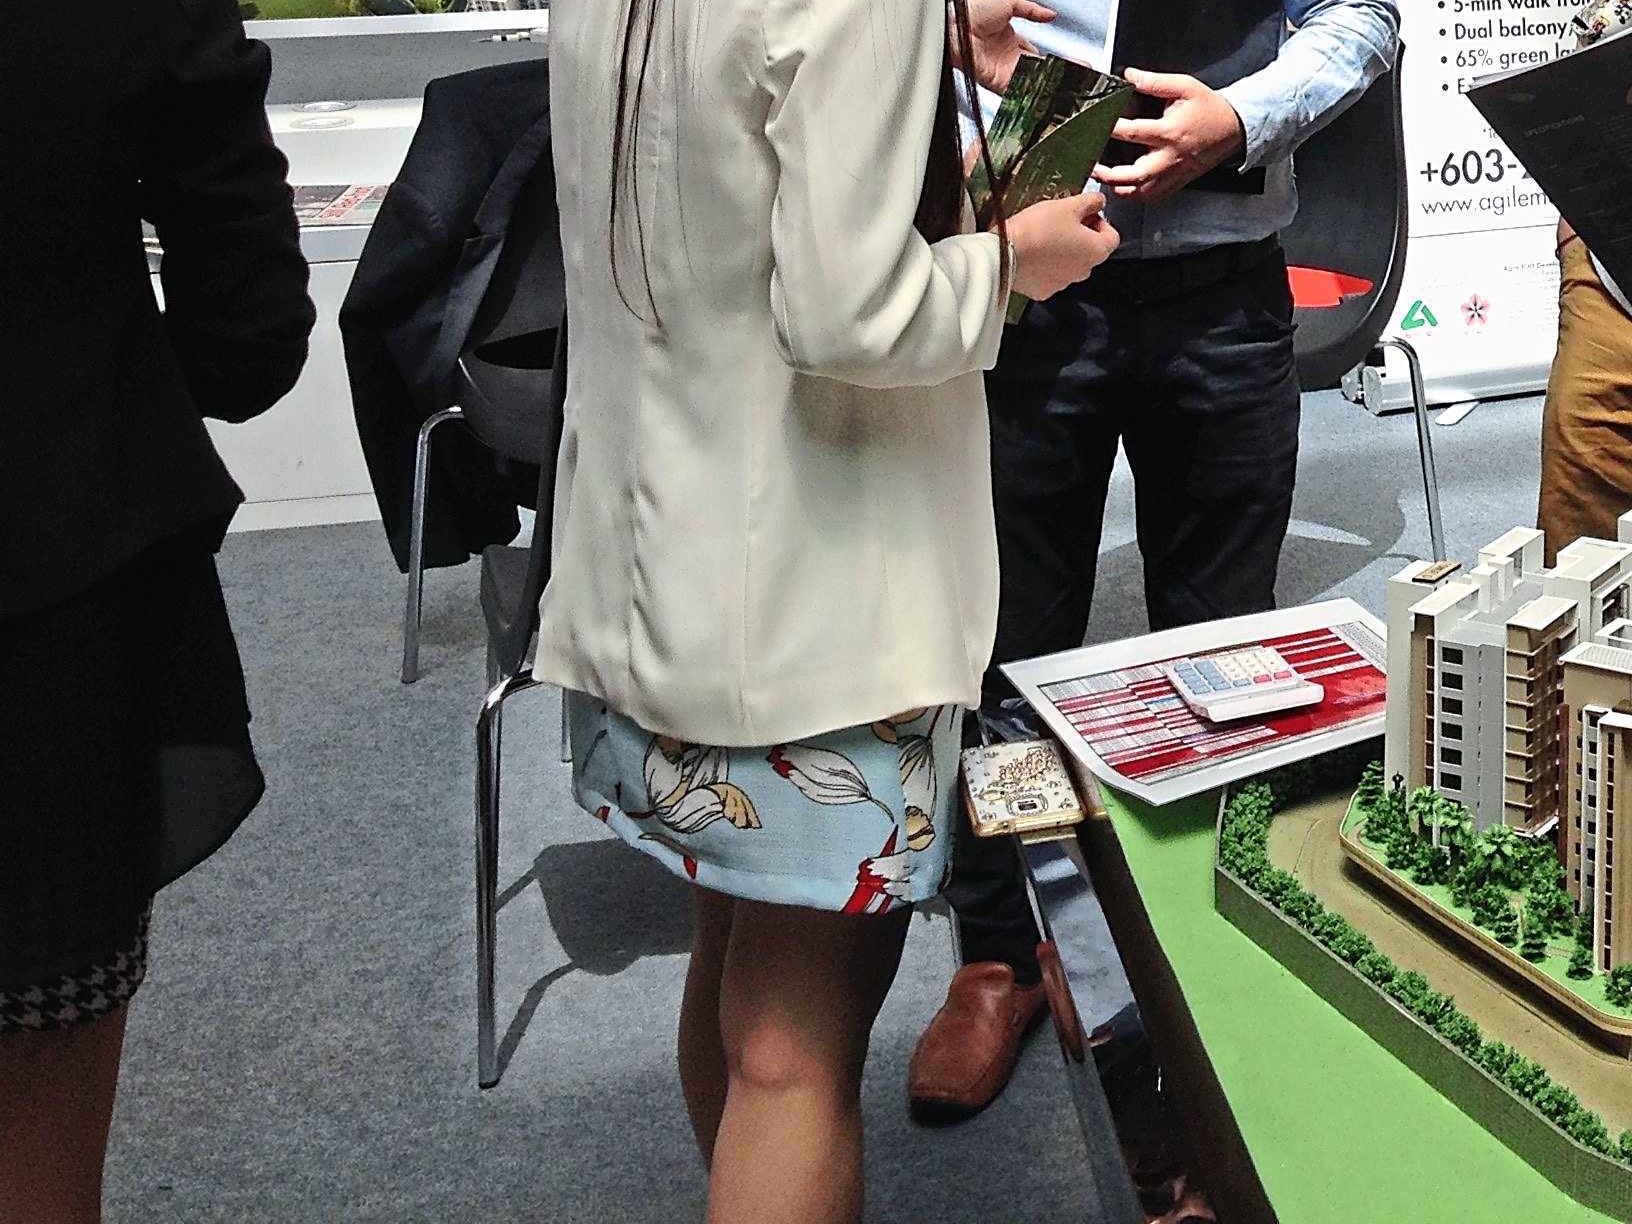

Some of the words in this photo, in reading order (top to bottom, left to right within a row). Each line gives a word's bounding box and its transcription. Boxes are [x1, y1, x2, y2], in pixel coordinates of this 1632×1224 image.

[1454, 19, 1493, 40] Dual
[1455, 48, 1493, 67] 65%
[1499, 49, 1549, 69] green
[1420, 148, 1532, 187] +603-
